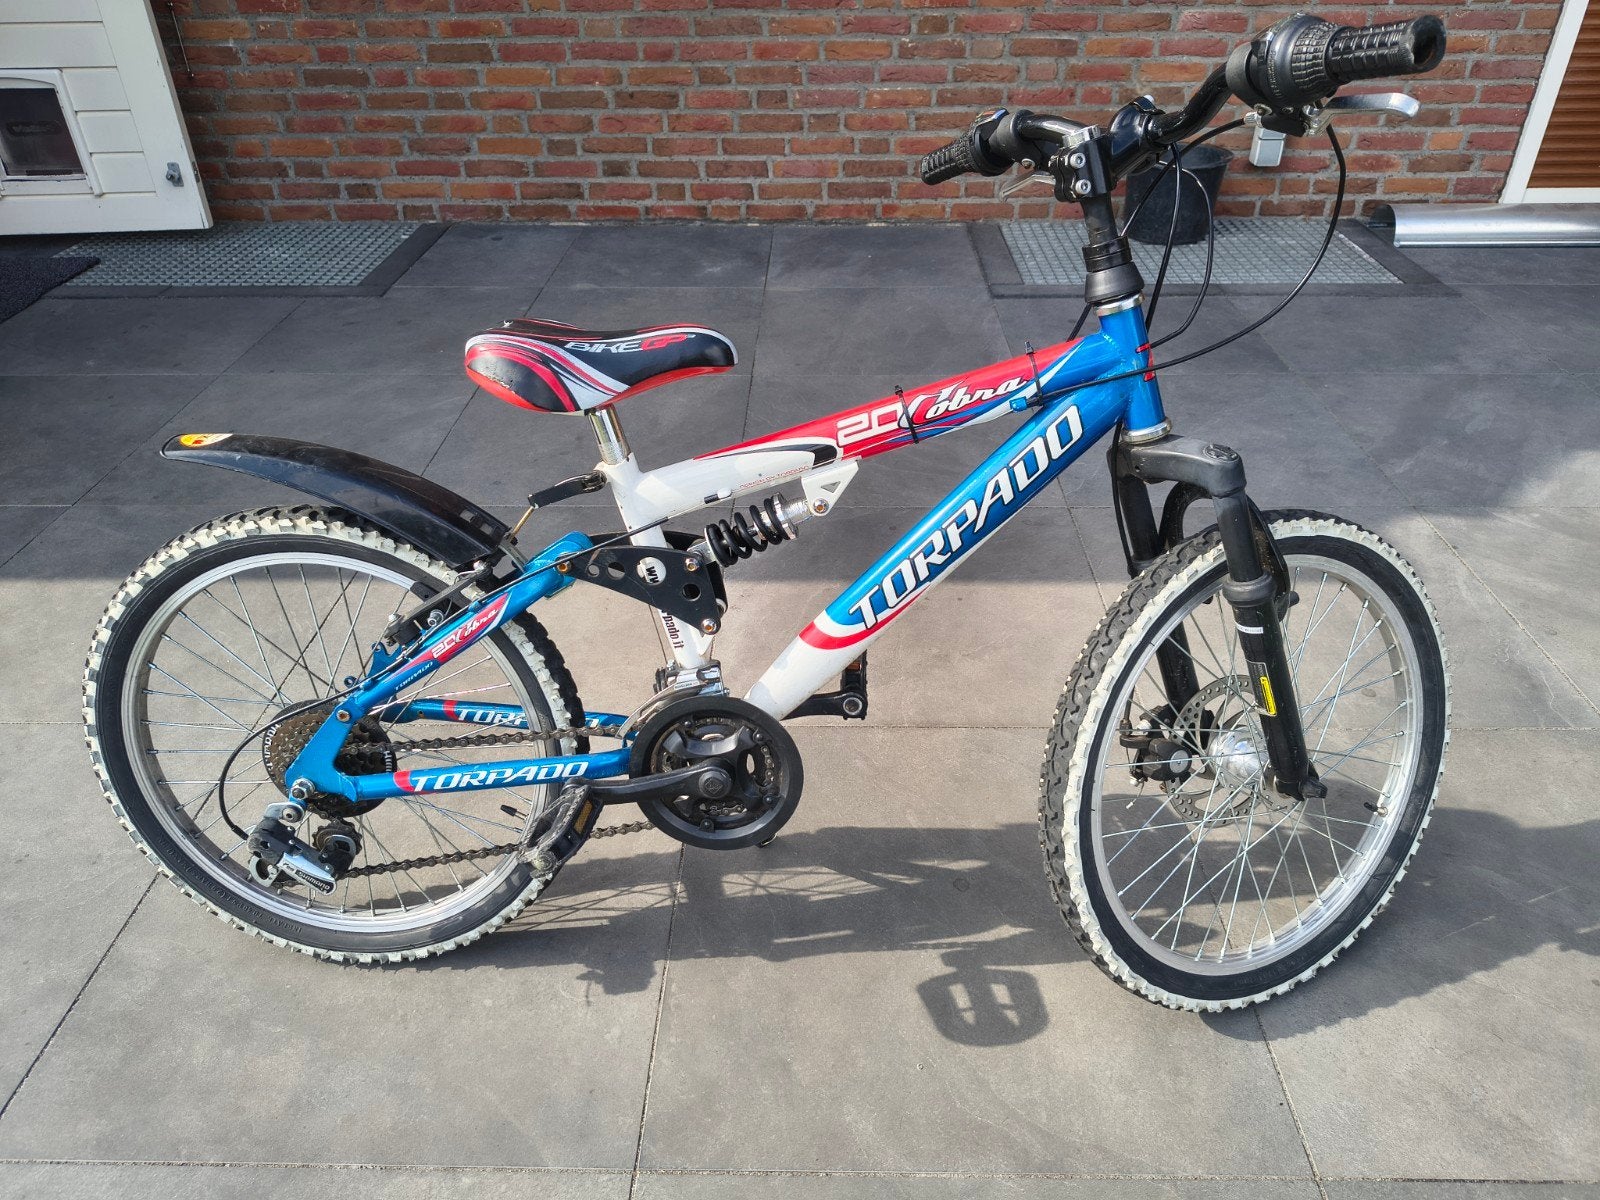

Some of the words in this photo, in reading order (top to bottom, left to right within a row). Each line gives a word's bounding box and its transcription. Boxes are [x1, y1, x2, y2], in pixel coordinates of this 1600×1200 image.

[897, 375, 1029, 429] Cobra
[849, 403, 1084, 630] TORPADO
[662, 611, 685, 649] pado.it
[411, 761, 589, 793] TORPADO
